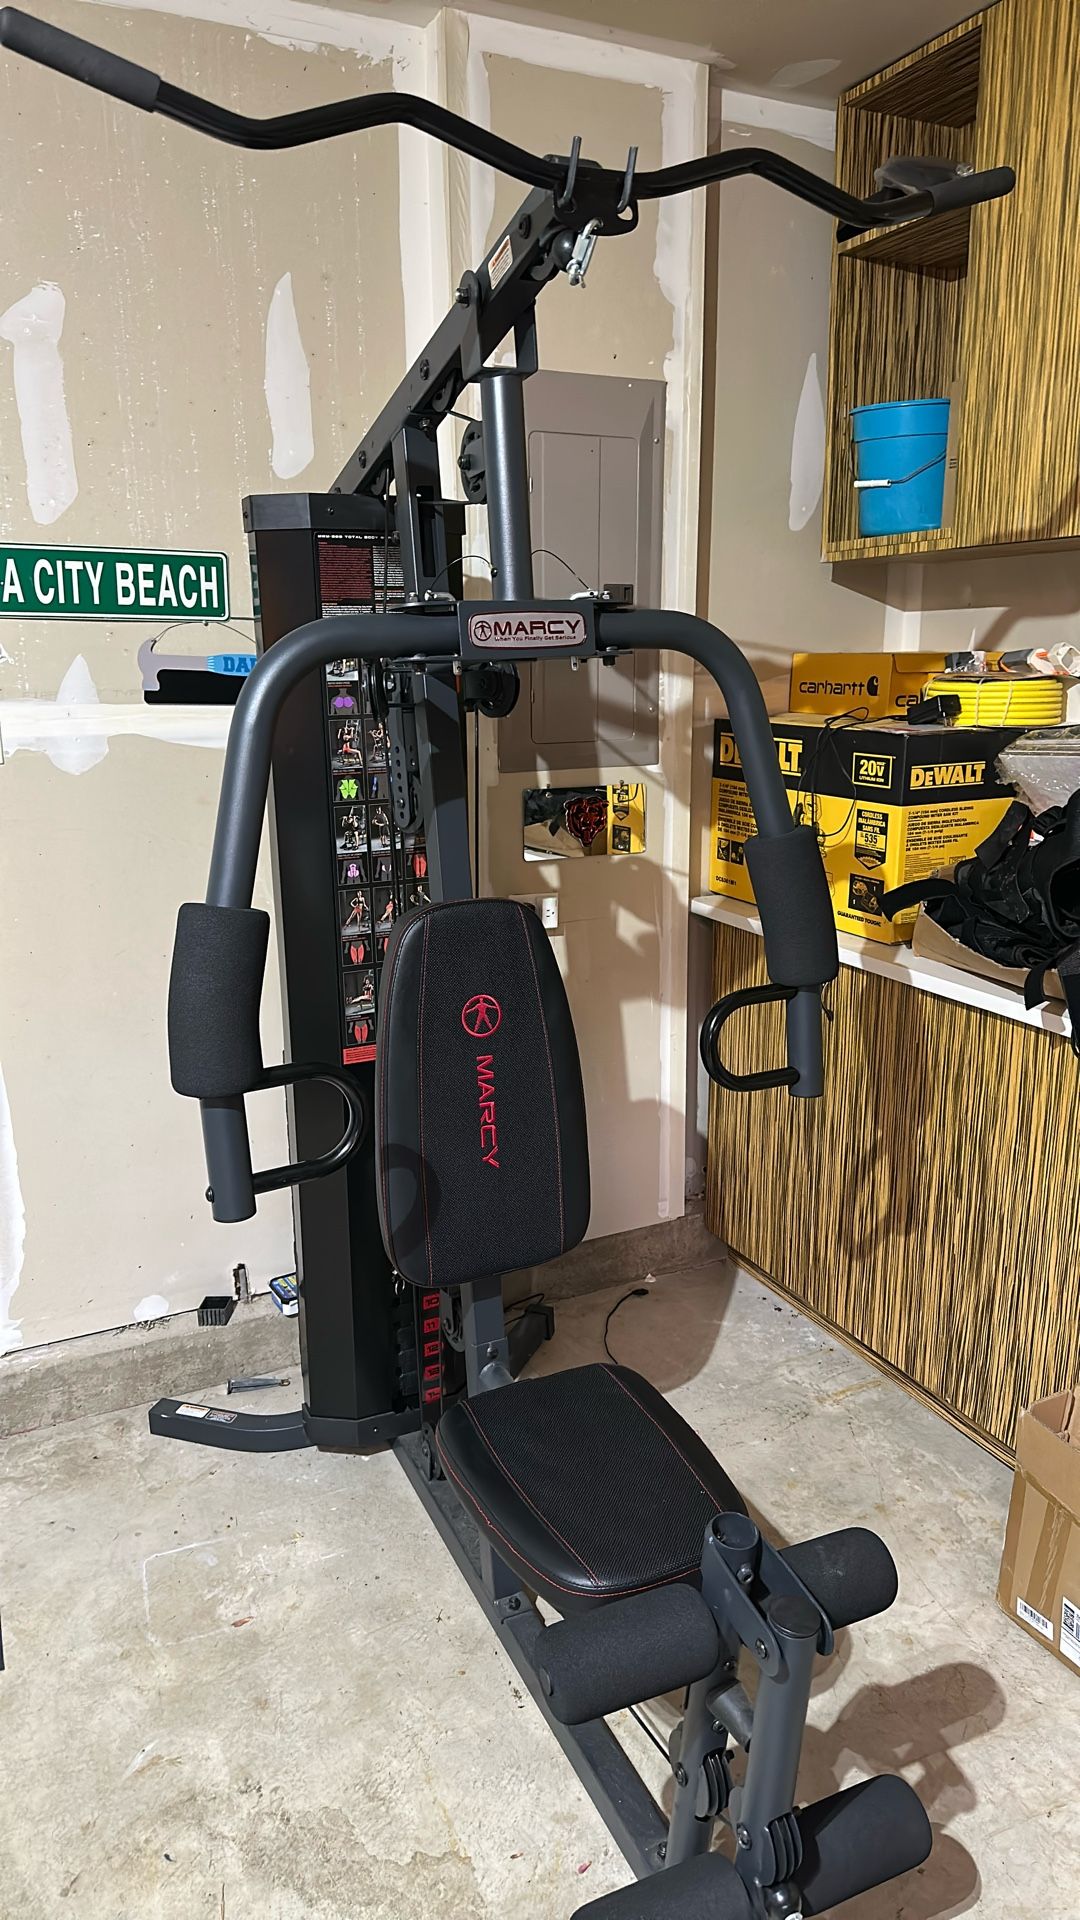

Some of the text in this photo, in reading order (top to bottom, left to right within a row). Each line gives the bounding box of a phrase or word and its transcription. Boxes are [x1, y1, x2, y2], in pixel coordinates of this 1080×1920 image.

[33, 558, 104, 605] CITY
[115, 562, 219, 609] BEACH
[493, 619, 581, 636] MARCY
[799, 680, 865, 696] carhartt
[910, 764, 986, 788] DEWALT
[864, 833, 878, 844] 535
[476, 1054, 500, 1169] MARCY
